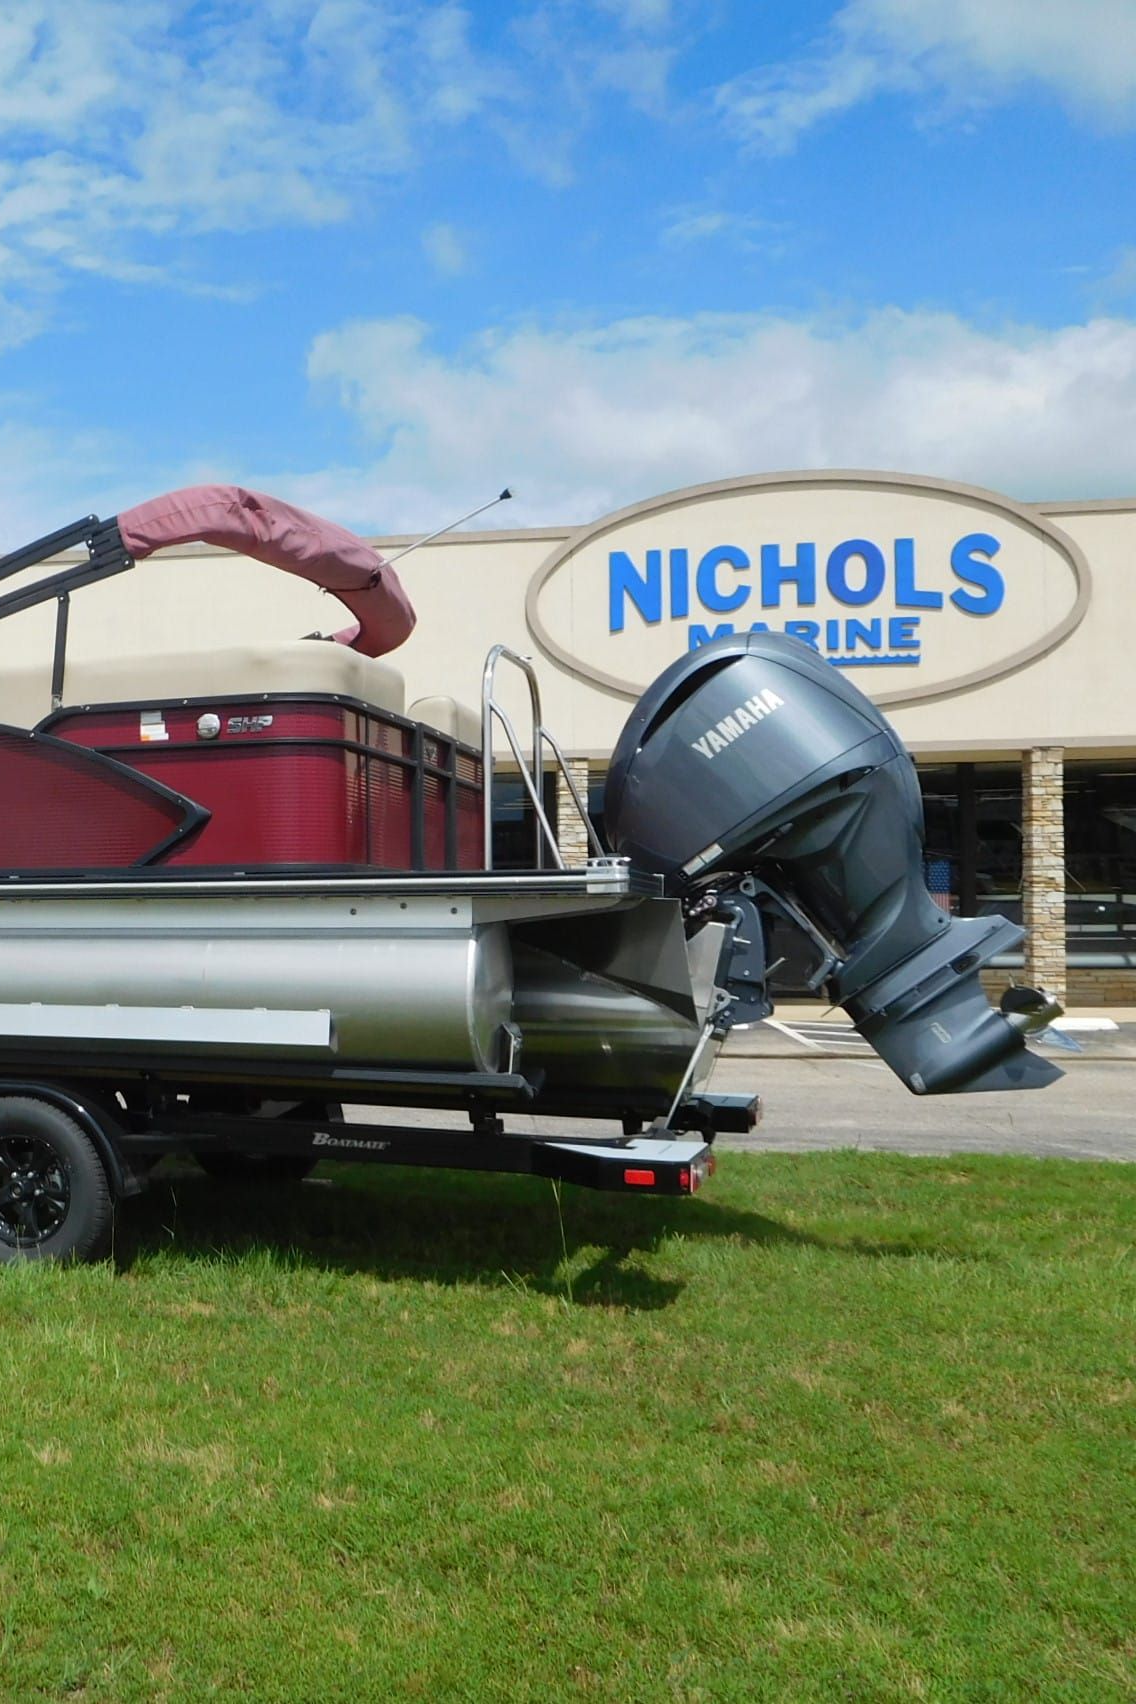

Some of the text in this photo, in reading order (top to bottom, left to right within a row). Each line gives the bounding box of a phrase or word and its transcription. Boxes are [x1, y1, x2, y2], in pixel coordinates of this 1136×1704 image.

[608, 532, 1006, 633] NICHOLS
[227, 715, 273, 733] SHP
[692, 688, 785, 760] YAMAHA
